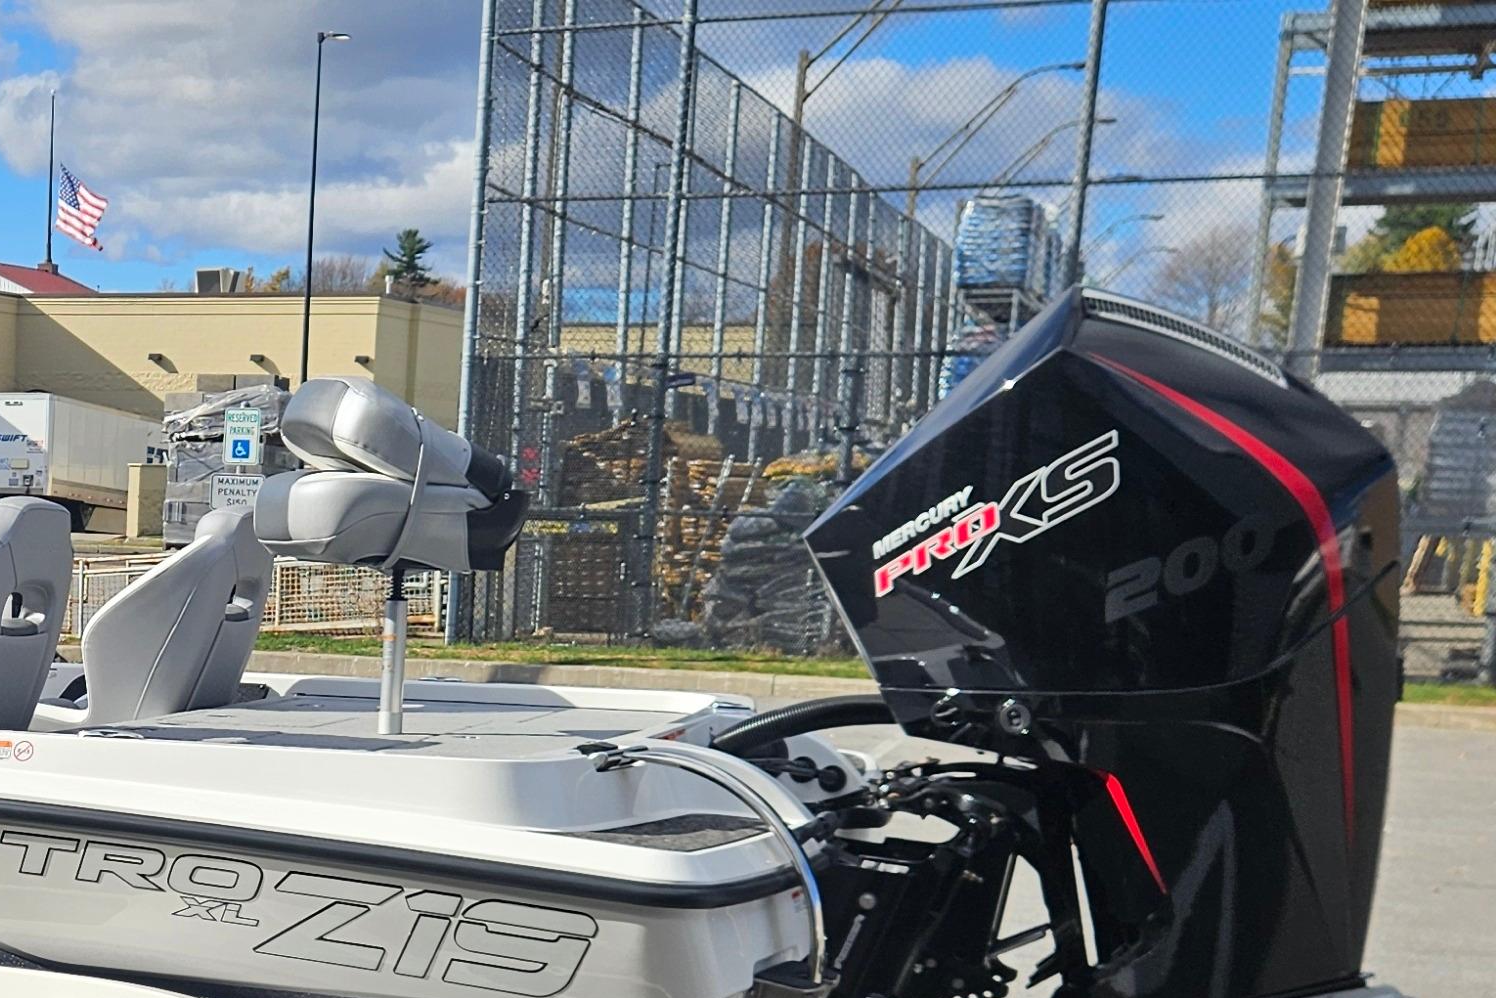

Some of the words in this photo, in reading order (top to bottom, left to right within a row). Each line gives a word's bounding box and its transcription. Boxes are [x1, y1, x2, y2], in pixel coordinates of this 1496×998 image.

[228, 413, 258, 422] RESERVED
[218, 478, 259, 486] MAXIMUM
[218, 488, 257, 496] PENALTY
[872, 485, 974, 559] MERCURY
[874, 501, 1001, 597] PRO
[951, 429, 1120, 579] XS
[1105, 513, 1279, 623] 200
[171, 895, 260, 927] XL
[253, 870, 599, 998] Z19
